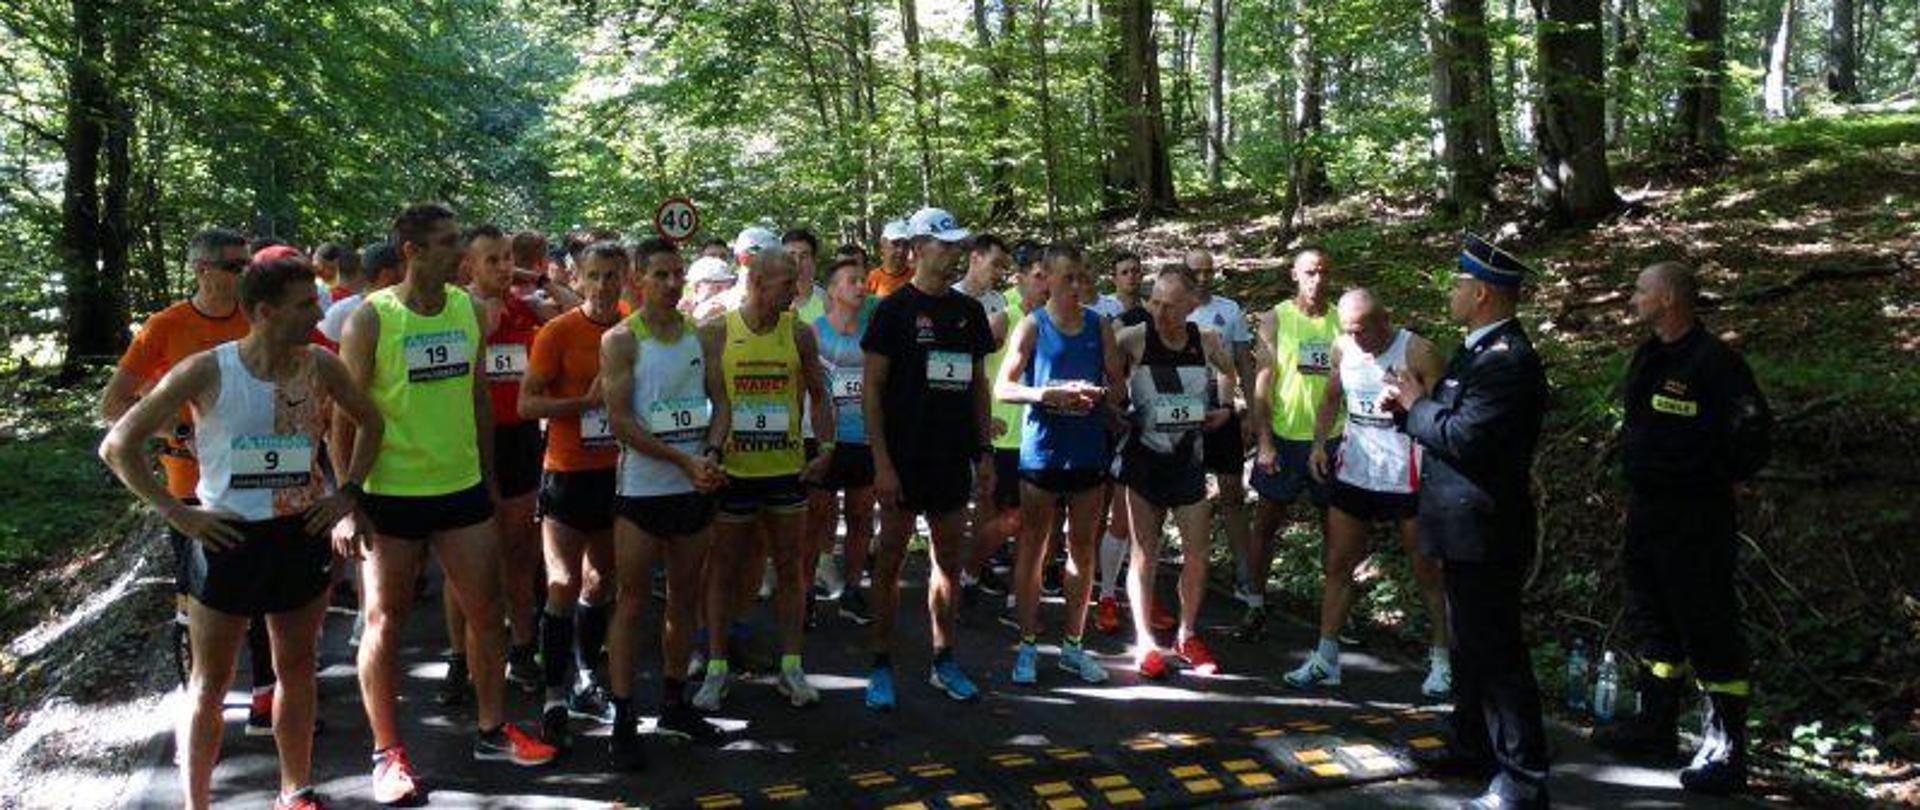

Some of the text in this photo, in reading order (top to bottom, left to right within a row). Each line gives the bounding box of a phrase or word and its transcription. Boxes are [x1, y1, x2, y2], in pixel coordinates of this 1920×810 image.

[663, 210, 693, 231] 40
[425, 345, 448, 365] 19
[495, 354, 512, 370] 61
[945, 362, 955, 378] 2
[671, 410, 692, 427] 10
[755, 414, 767, 429] 8
[1171, 407, 1190, 423] 45
[264, 451, 280, 470] 9
